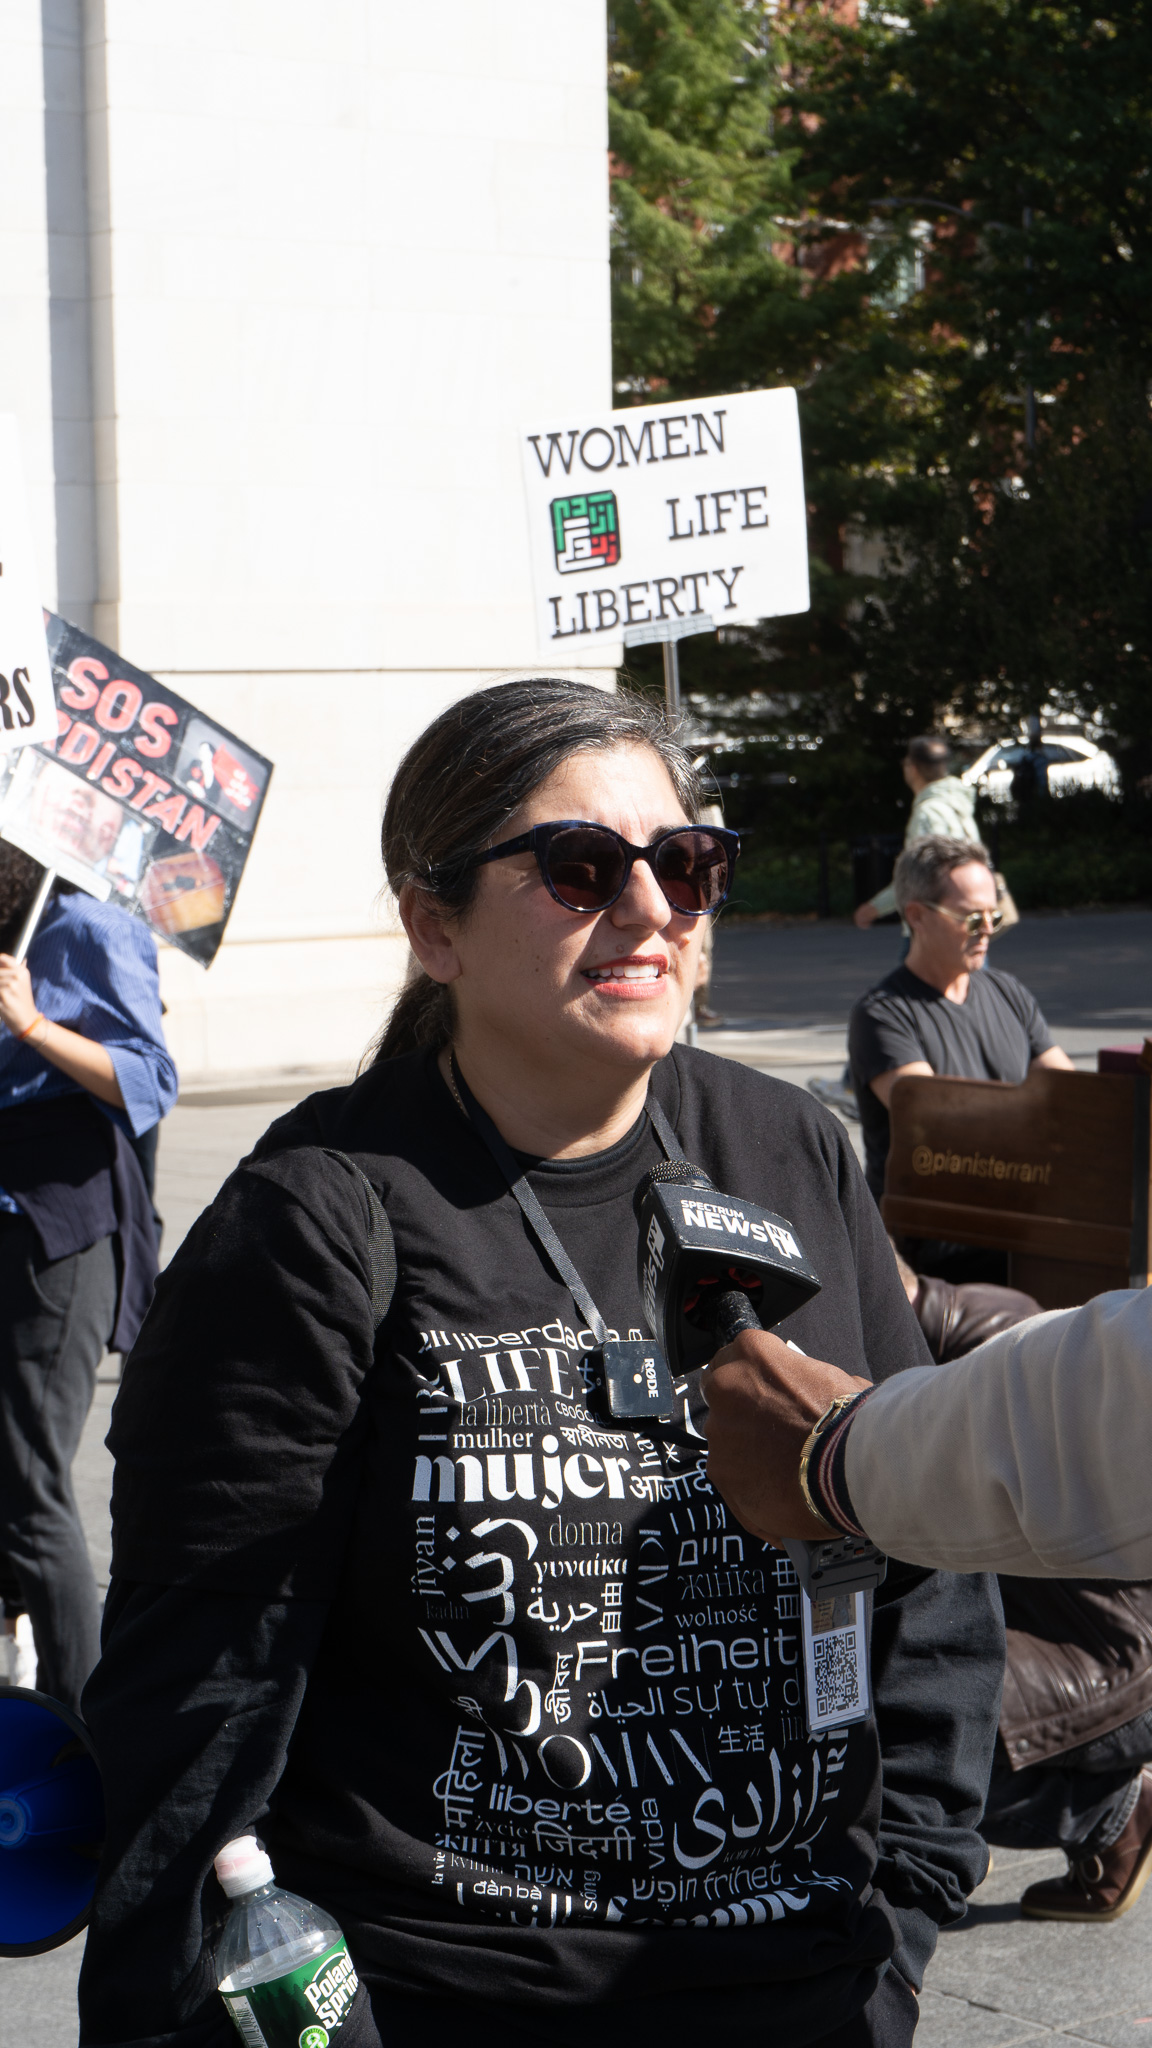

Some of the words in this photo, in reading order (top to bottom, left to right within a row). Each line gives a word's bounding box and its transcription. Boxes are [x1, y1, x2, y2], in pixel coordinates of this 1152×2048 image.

[526, 409, 727, 478] WOMEN
[665, 486, 770, 541] LIFE
[548, 566, 744, 640] LIBERTY
[60, 656, 179, 759] SOS
[680, 1199, 745, 1220] SPECTRUM
[681, 1207, 769, 1243] NEWS
[440, 1347, 575, 1404] LIFE
[643, 1357, 659, 1399] RØDE
[458, 1401, 478, 1427] la
[484, 1397, 552, 1427] libertà
[453, 1428, 534, 1450] mulher
[411, 1434, 632, 1510] mujer
[548, 1514, 624, 1548] donna
[677, 1534, 745, 1567] חיים
[673, 1604, 759, 1629] wolność
[574, 1627, 799, 1682] Freiheit
[717, 1723, 766, 1754] 生活
[488, 1782, 632, 1826] liberté
[640, 1797, 666, 1870] vida
[703, 1859, 783, 1901] frihet
[303, 1946, 355, 2013] Poland
